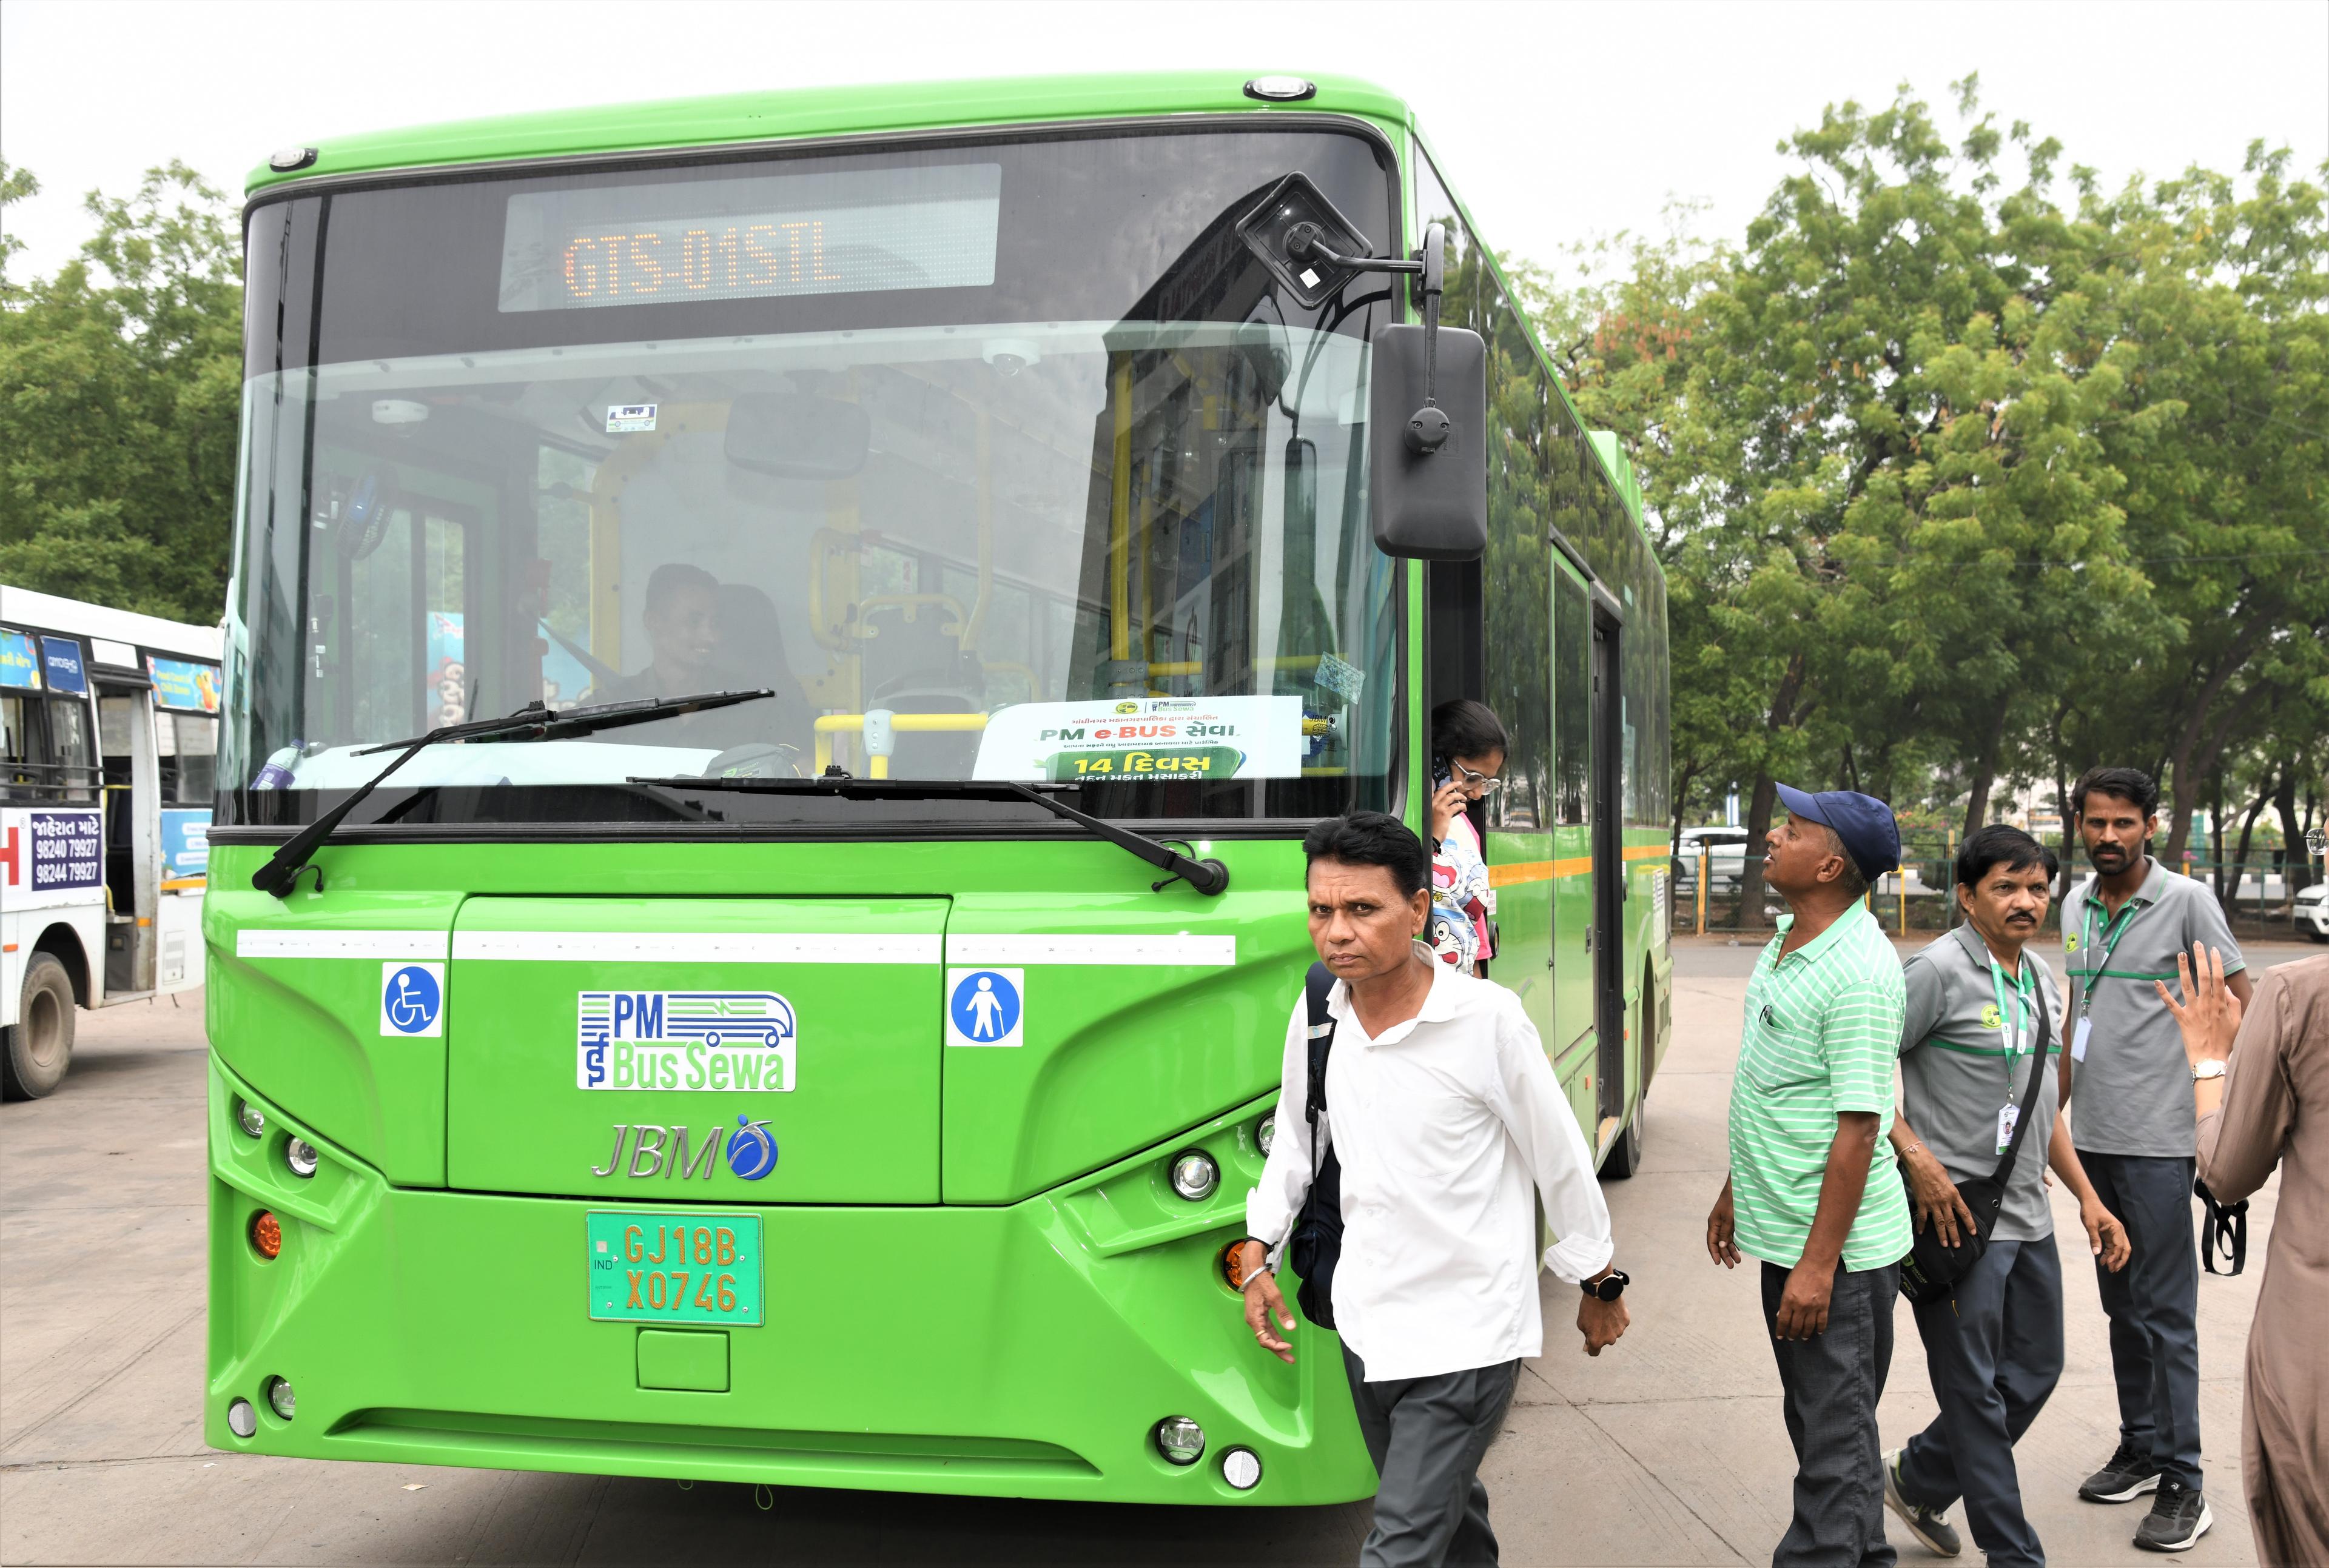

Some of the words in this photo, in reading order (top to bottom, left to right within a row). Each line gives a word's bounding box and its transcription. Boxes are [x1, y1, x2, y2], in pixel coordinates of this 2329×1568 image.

[1040, 728, 1085, 741] PM
[1094, 725, 1176, 739] e-BUS
[1185, 720, 1234, 737] સેવા
[1074, 758, 1114, 774] 14
[1123, 751, 1211, 772] દિવસ
[32, 816, 76, 837] જાહેરાત
[78, 815, 100, 836] માટે
[36, 839, 67, 859] 98240
[68, 839, 98, 857] 79927
[36, 863, 67, 883] 98244
[69, 862, 98, 881] 79927
[614, 994, 664, 1039] PM
[613, 1041, 679, 1089] Bus
[686, 1040, 785, 1090] Sewa
[591, 1124, 724, 1180] JBM
[625, 1224, 736, 1265] GJ18B
[594, 1259, 613, 1270] IND
[626, 1270, 736, 1312] X0746
